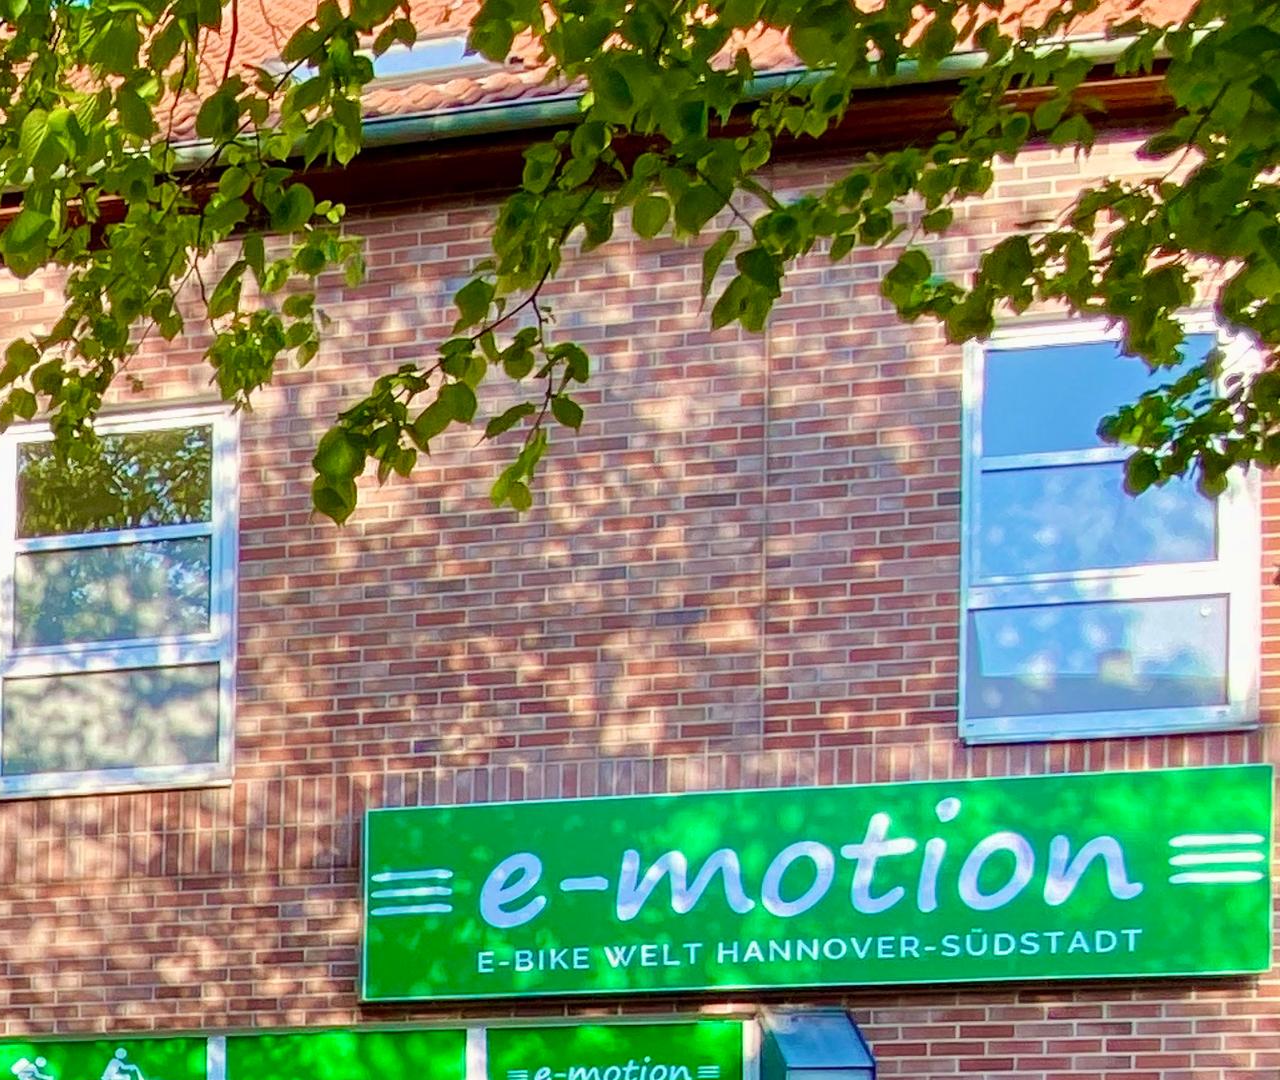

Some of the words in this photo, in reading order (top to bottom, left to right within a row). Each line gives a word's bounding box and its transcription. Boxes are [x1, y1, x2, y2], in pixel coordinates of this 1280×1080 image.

[479, 797, 1144, 928] e-motion
[477, 947, 590, 973] E-BIKE
[604, 942, 703, 968] WELT
[717, 928, 1143, 964] HANNOVER-SÜDSTADT
